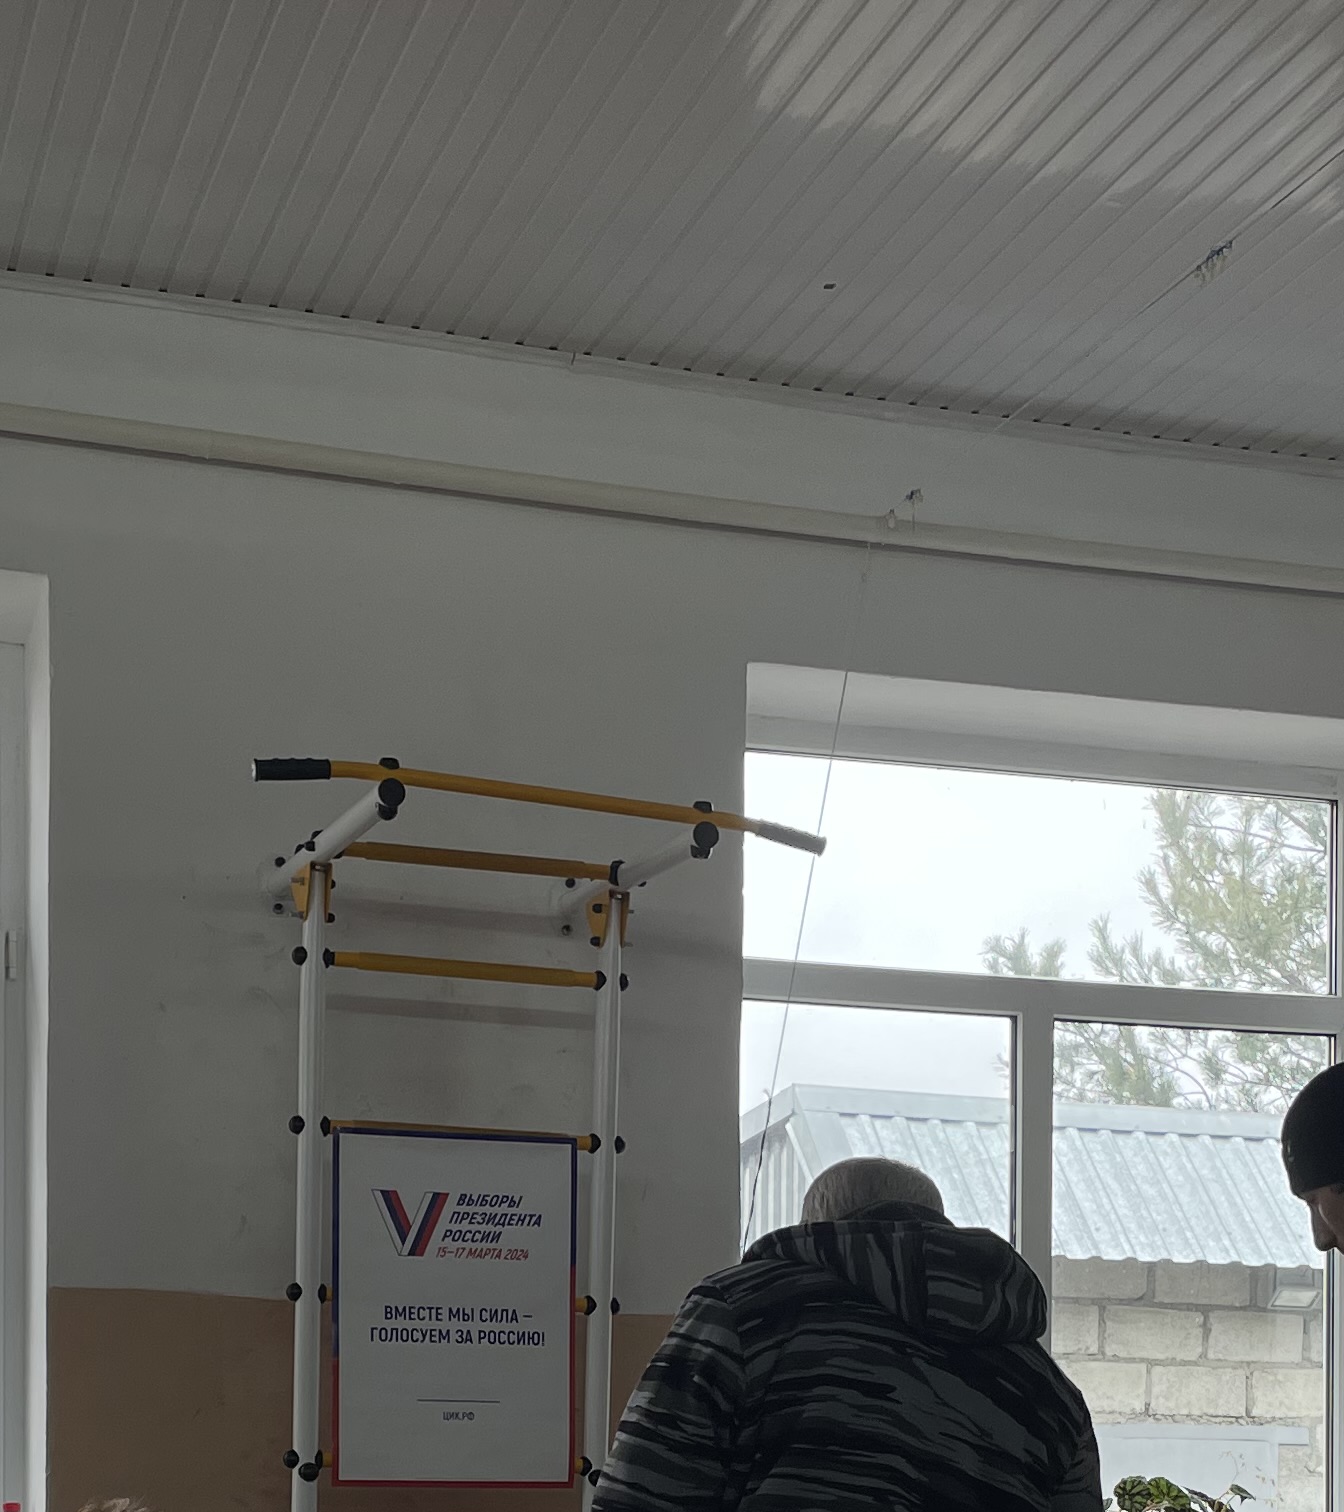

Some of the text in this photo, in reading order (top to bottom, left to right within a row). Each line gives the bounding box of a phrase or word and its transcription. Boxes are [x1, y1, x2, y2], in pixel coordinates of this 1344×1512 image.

[456, 1193, 523, 1208] ВЫБОРЫ
[448, 1211, 542, 1228] ПРЕЗИДЕНТА
[441, 1229, 502, 1244] РОССИИ
[466, 1247, 502, 1260] МАРТА
[504, 1249, 529, 1261] 2024
[384, 1305, 443, 1321] ВМЕСТЕ
[448, 1307, 475, 1323] МЫ
[479, 1308, 519, 1324] СИЛА
[369, 1326, 545, 1347] ГОЛОСУЕМ ЗА РОССИЮ!
